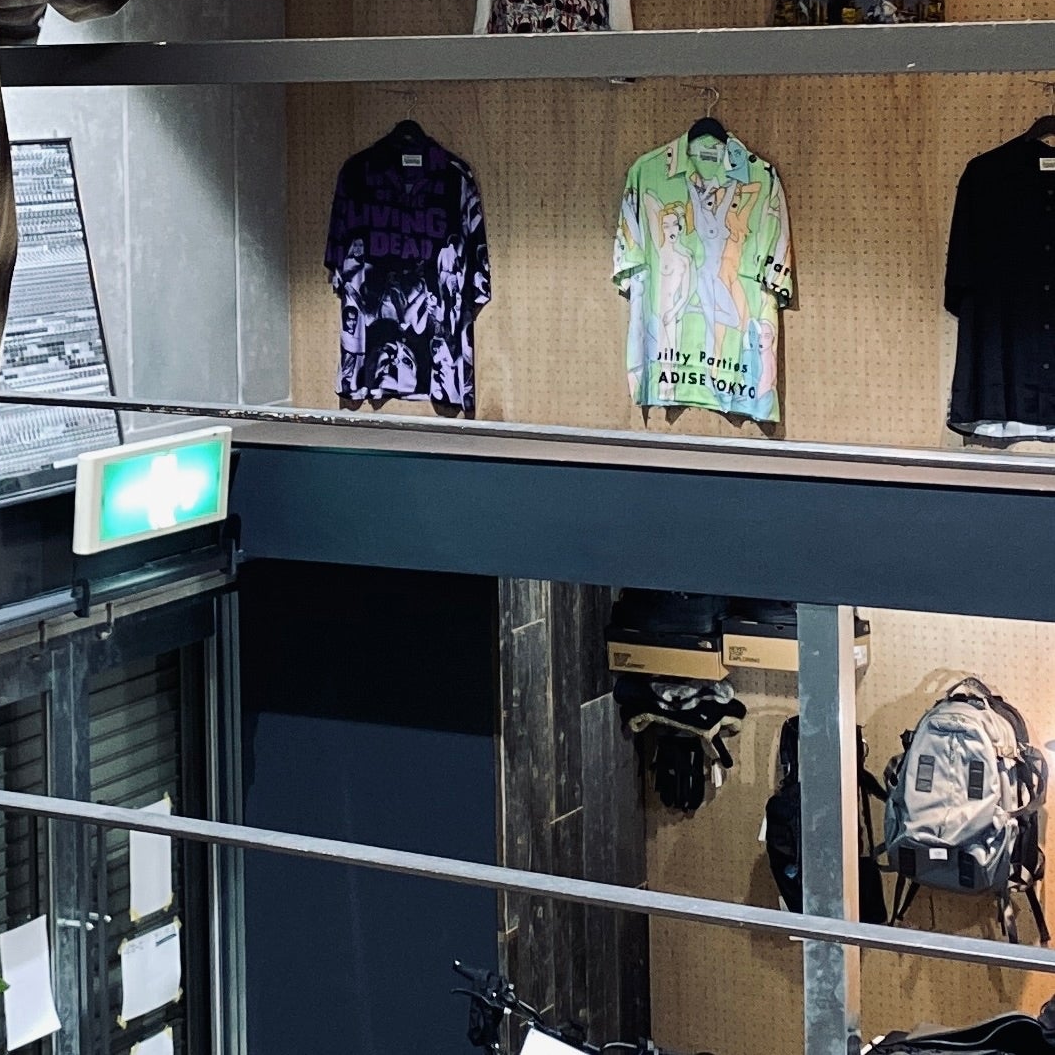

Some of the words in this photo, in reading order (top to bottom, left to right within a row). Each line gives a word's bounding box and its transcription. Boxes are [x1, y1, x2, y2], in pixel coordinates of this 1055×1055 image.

[346, 200, 448, 239] LIVING
[368, 230, 435, 260] DEAD
[699, 351, 749, 373] Parties
[658, 371, 706, 386] ADISE
